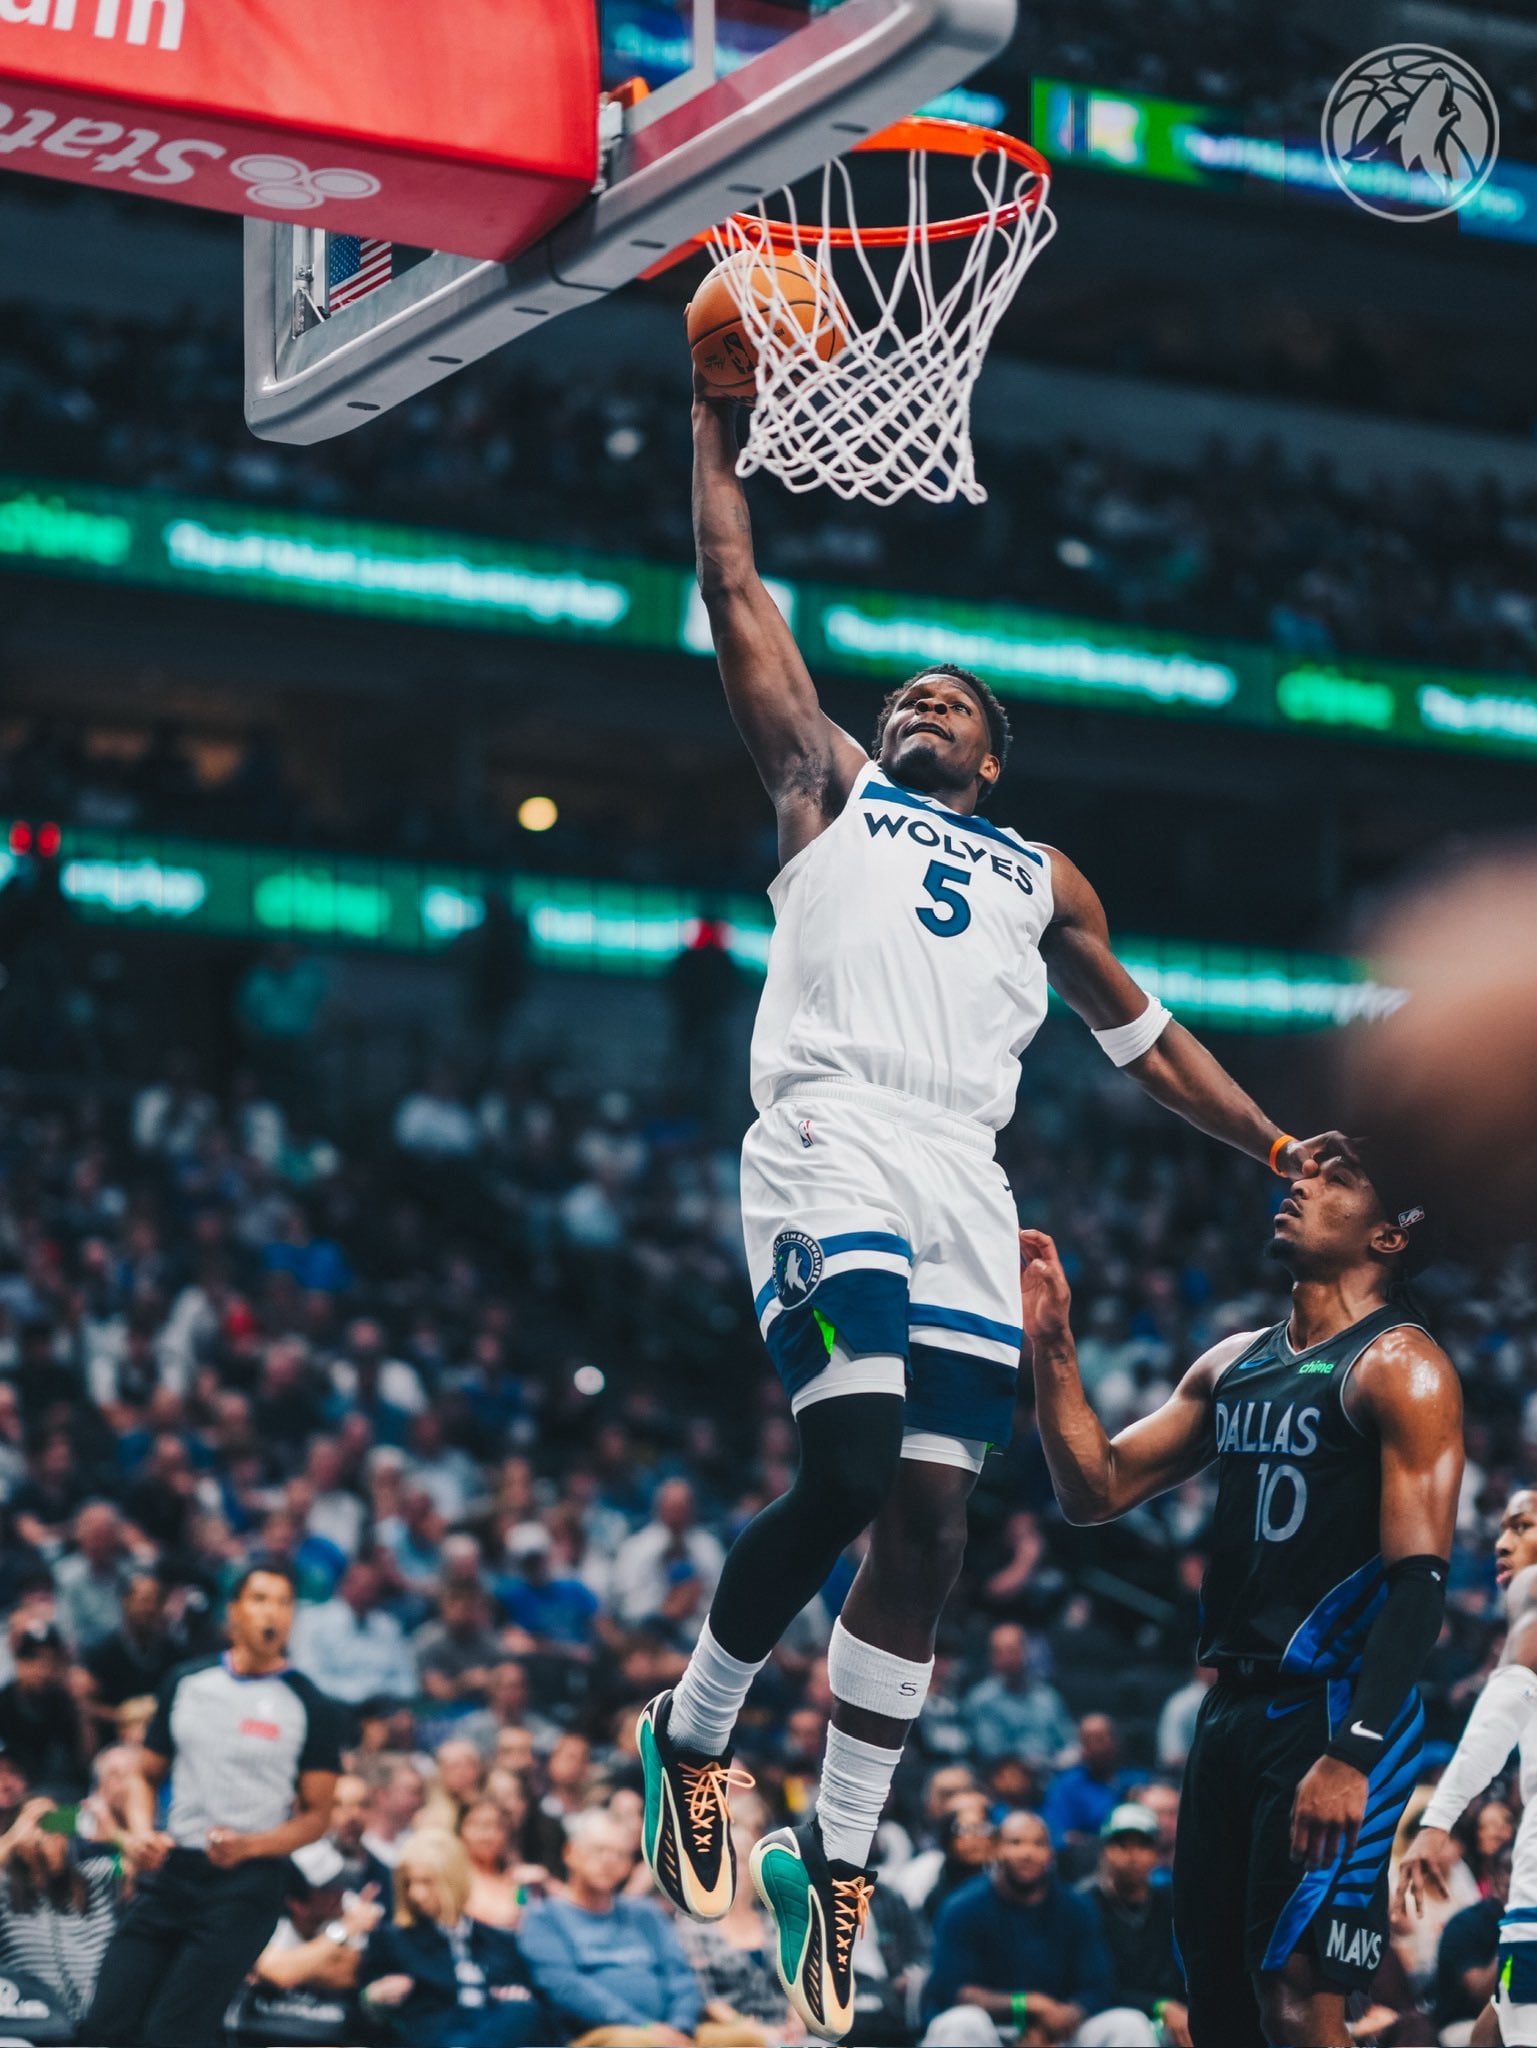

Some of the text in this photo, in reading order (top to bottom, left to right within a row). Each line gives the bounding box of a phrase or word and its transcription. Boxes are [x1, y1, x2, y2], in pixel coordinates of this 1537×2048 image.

[863, 812, 1034, 896] WOLVES
[915, 859, 972, 938] 5
[781, 1232, 821, 1283] TIMBERWOLVES
[1299, 1360, 1335, 1374] chime
[1216, 1401, 1320, 1457] DALLAS
[1254, 1463, 1307, 1542] 10
[1326, 1919, 1382, 1970] MAVS
